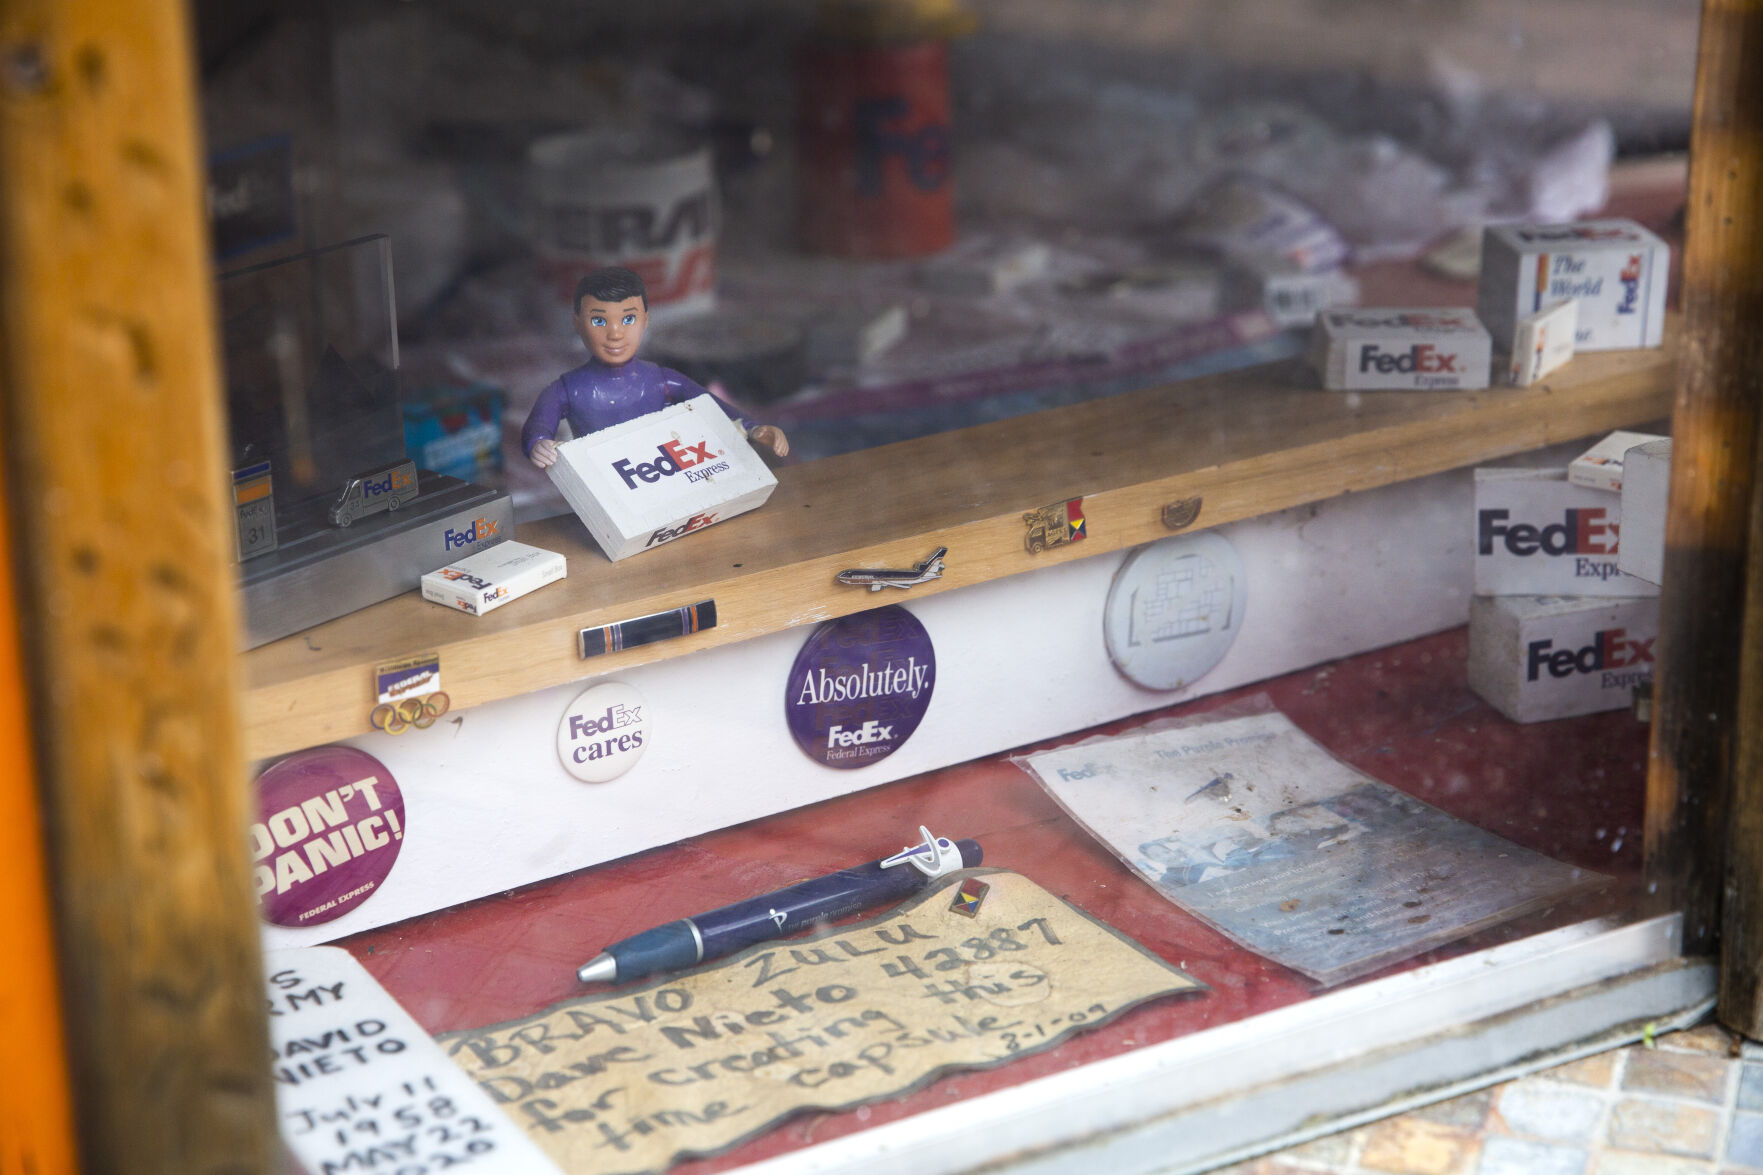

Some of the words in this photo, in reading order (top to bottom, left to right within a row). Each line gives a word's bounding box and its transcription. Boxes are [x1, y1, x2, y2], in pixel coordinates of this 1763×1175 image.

[1359, 343, 1458, 374] FedEx
[610, 438, 719, 491] FedEx
[683, 460, 730, 483] Express
[363, 470, 412, 499] FedEx
[444, 517, 499, 551] FedEx
[644, 512, 719, 548] FedEx
[483, 586, 509, 605] FedEx
[1527, 627, 1656, 683] FedEx
[796, 656, 929, 705] Absolutely.
[569, 703, 643, 741] FedEx
[827, 720, 893, 749] FedEx
[573, 729, 643, 764] cares
[826, 745, 858, 761] Federal
[859, 744, 891, 758] Express
[298, 900, 338, 921] FEDERAL
[338, 880, 375, 905] EXPRESS
[451, 987, 694, 1071] BRAVO
[744, 924, 940, 989] ZULU
[272, 1019, 387, 1061] AVID
[480, 1046, 657, 1105] Dave
[519, 1086, 627, 1133] for
[647, 1008, 907, 1087] creating
